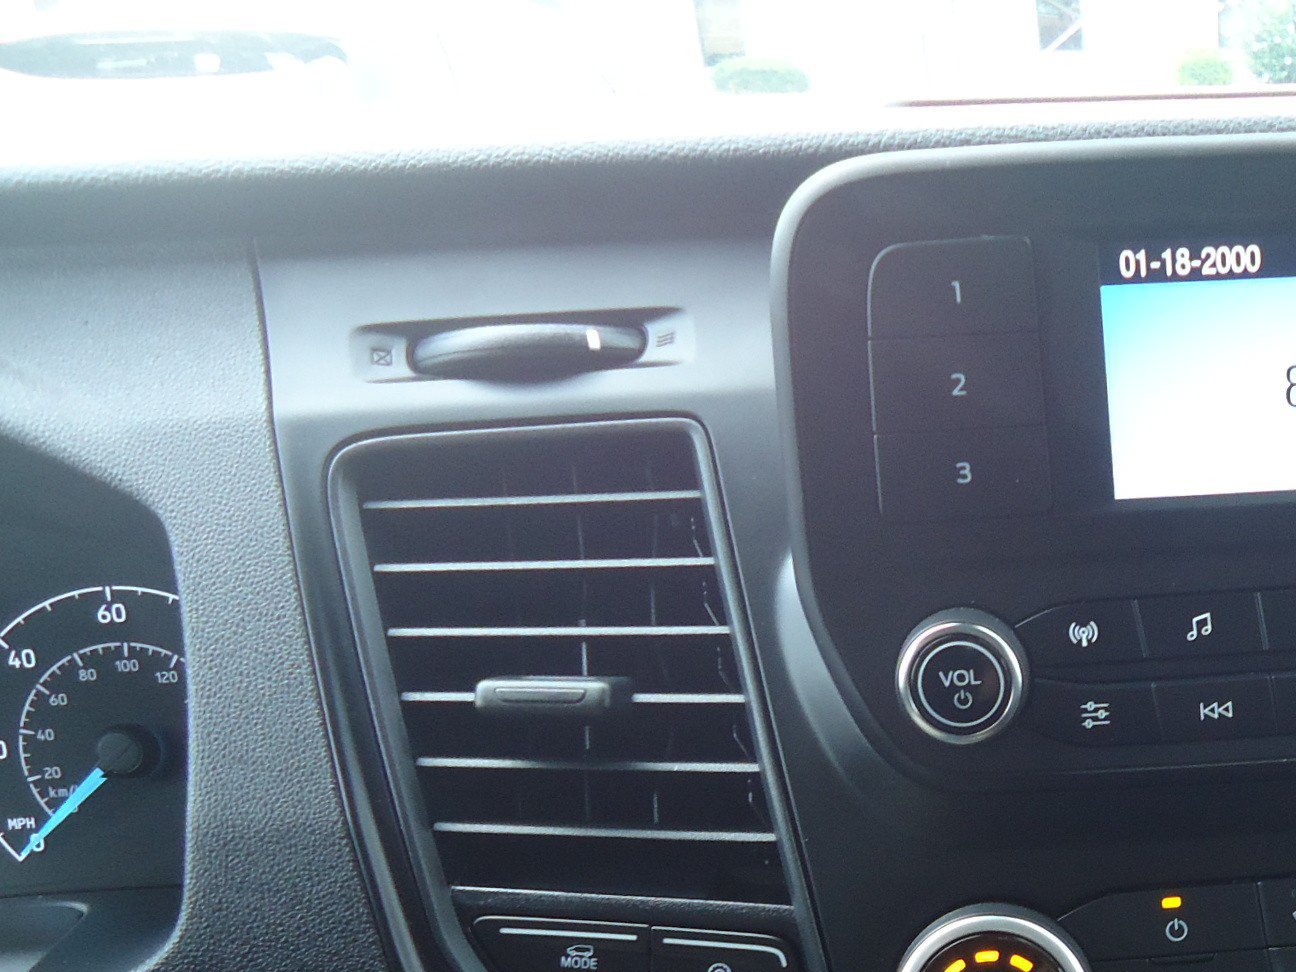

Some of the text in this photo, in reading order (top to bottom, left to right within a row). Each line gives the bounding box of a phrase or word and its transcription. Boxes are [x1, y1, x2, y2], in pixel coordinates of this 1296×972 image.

[1119, 245, 1261, 278] 01-18-2000
[950, 280, 962, 304] 1
[950, 372, 967, 396] 2
[955, 461, 972, 484] 3
[97, 603, 126, 624] 60
[7, 648, 36, 669] 40
[115, 660, 139, 672] 100
[78, 669, 97, 681] 80
[155, 671, 178, 683] 120
[938, 670, 982, 688] VOL
[49, 693, 67, 706] 60
[36, 728, 55, 741] 40
[43, 766, 61, 779] 20
[48, 784, 78, 798] km/
[7, 817, 36, 831] MPH
[560, 956, 598, 970] MODE
